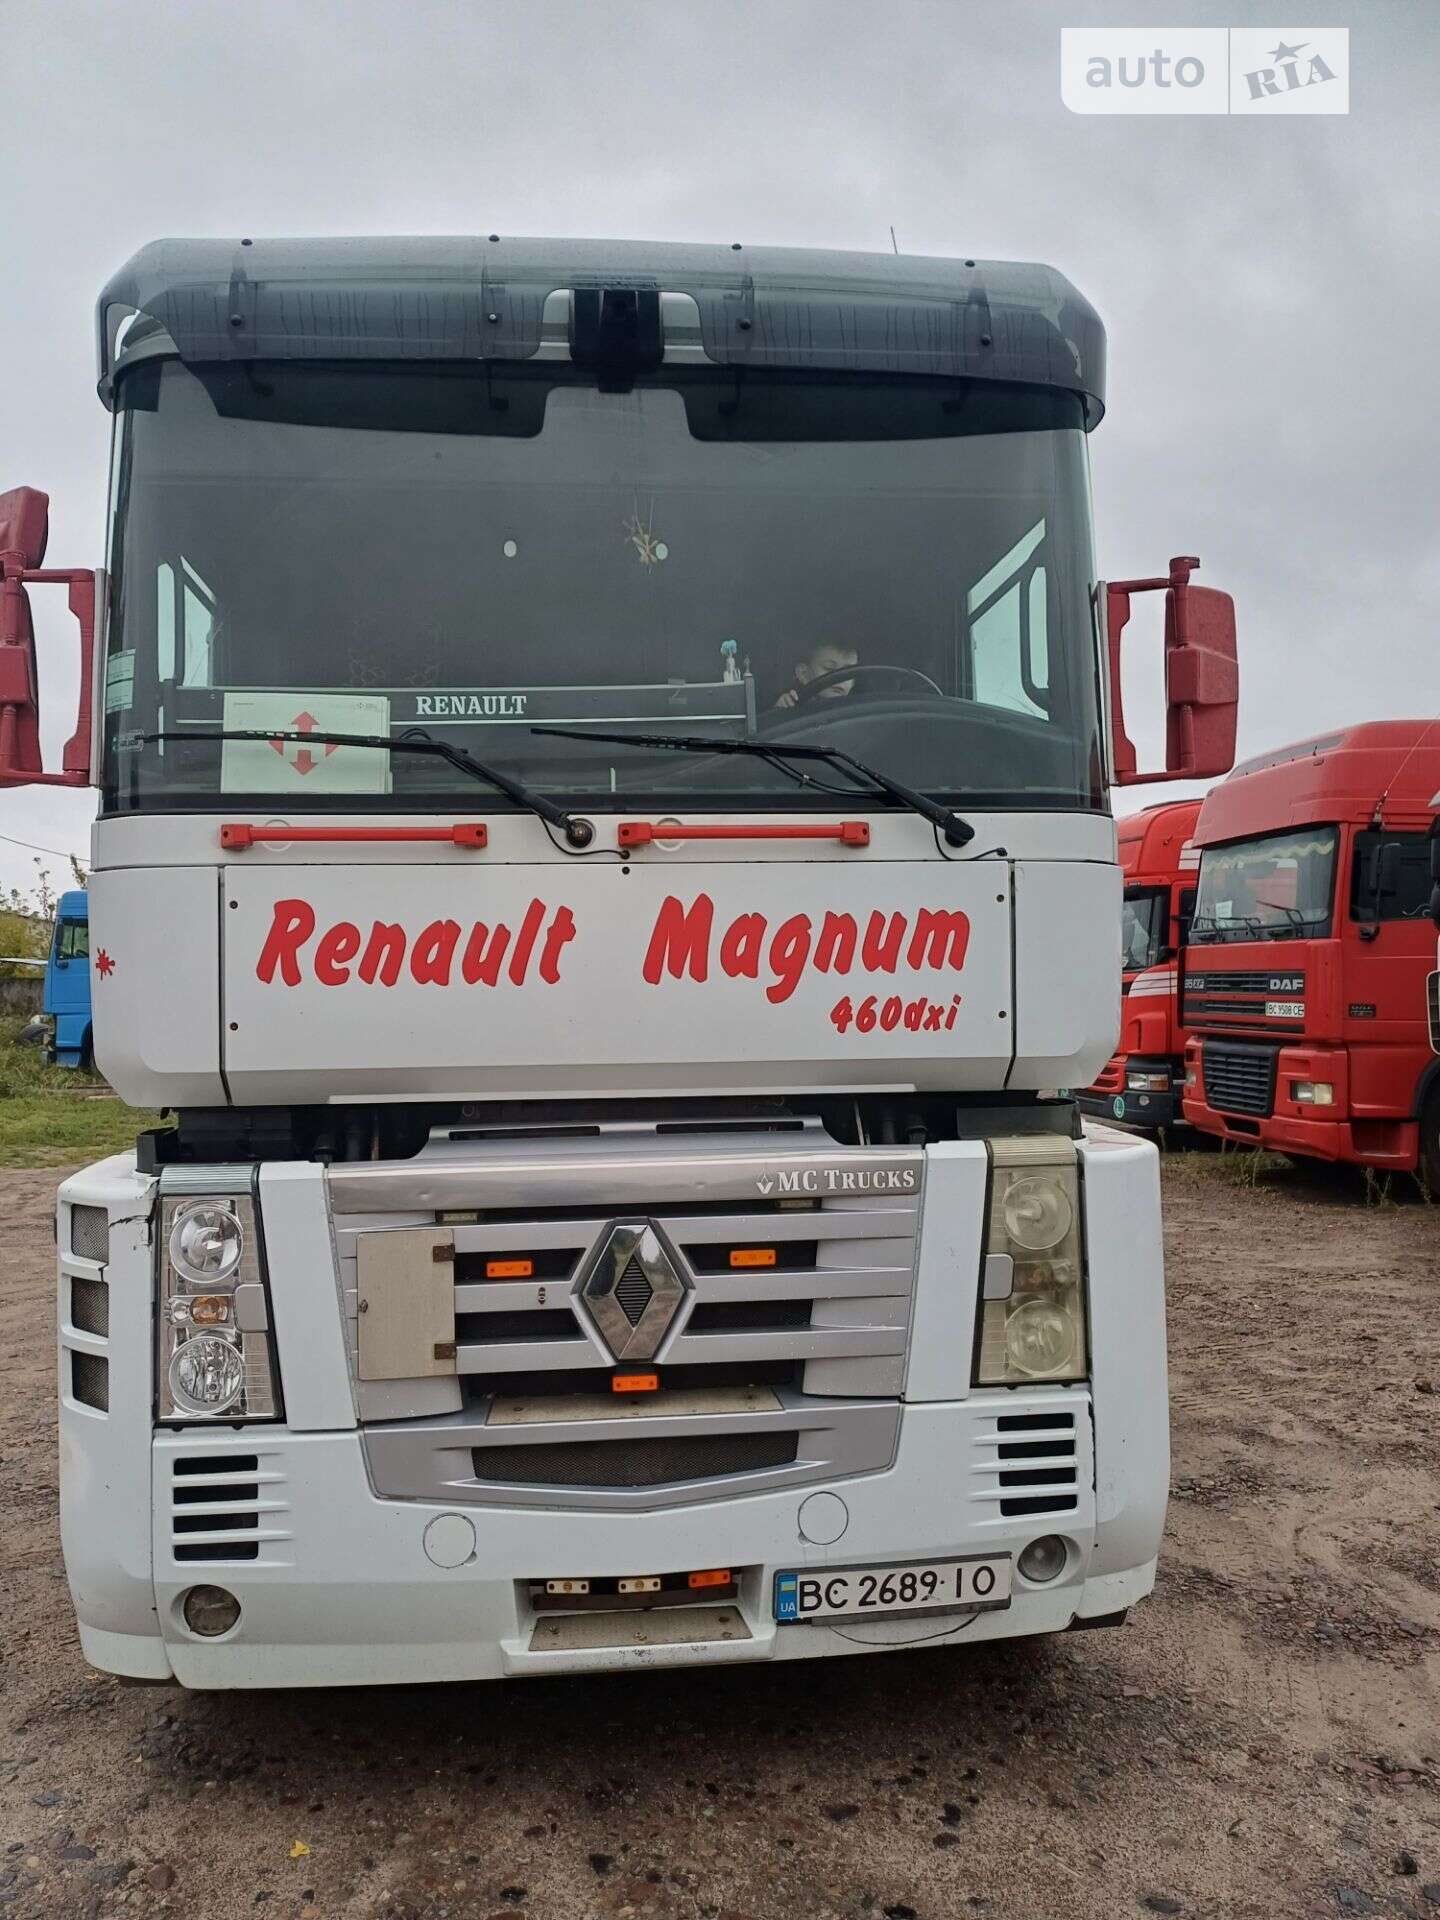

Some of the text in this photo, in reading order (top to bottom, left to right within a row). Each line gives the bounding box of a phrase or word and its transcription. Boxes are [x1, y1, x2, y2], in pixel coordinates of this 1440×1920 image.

[415, 694, 528, 715] RENAULT
[256, 893, 971, 1005] Renault Magnum
[1269, 979, 1304, 990] DAF
[830, 995, 962, 1034] 460dxi
[777, 1169, 915, 1192] MC TRUCKS
[799, 1565, 996, 1612] BC 2689 IO
[780, 1603, 796, 1613] UA
